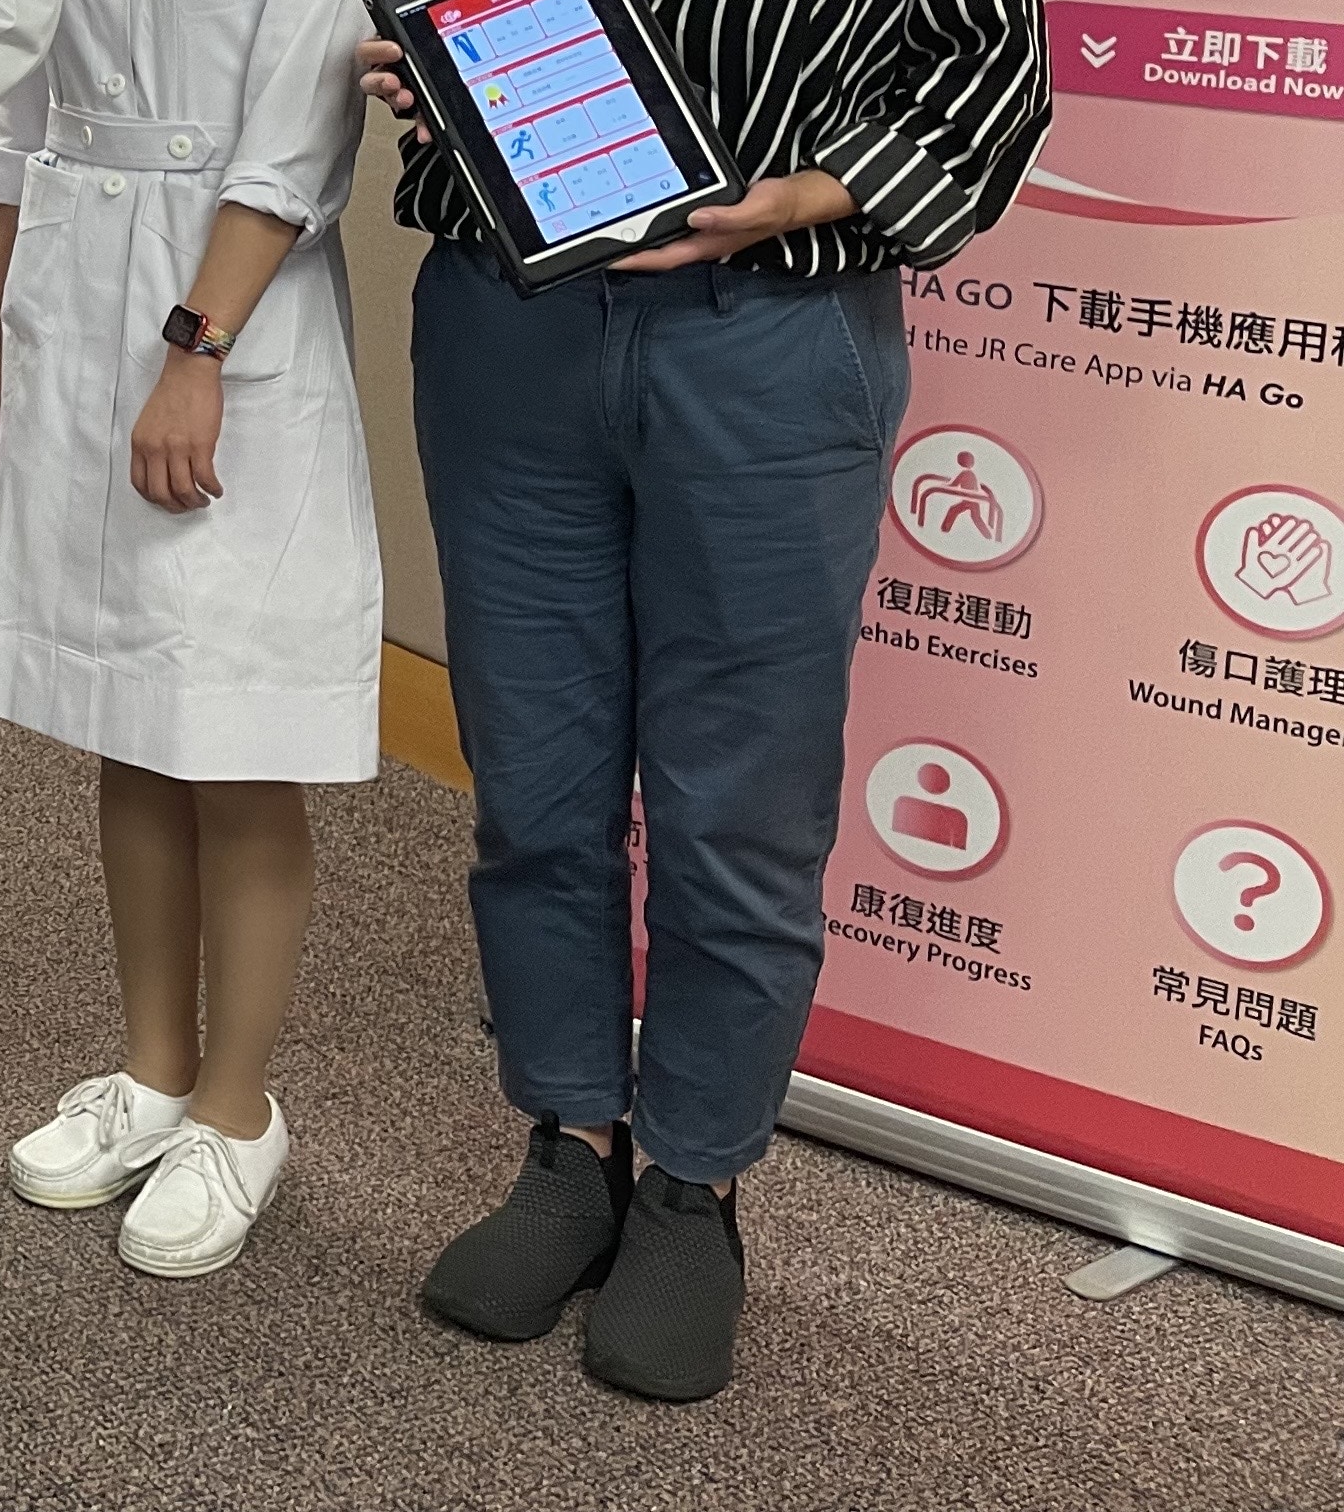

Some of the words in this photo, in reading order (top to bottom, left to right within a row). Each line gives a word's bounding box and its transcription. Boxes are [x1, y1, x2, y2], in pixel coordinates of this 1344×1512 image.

[1144, 64, 1276, 94] Download
[1284, 77, 1344, 100] Now
[1161, 27, 1328, 74] 立即下載
[956, 279, 1012, 309] GO
[924, 329, 968, 356] the
[975, 337, 1005, 362] JR
[1014, 343, 1076, 373] Care
[1083, 355, 1143, 387] App
[1151, 365, 1192, 392] via
[1203, 374, 1246, 401] HA
[1259, 382, 1304, 409] Go
[876, 575, 1033, 640] 復康運動
[860, 621, 920, 651] ehab
[927, 635, 1039, 678] Exercises
[1178, 638, 1344, 705] 傷口護理
[1127, 678, 1222, 721] Wound
[1230, 702, 1344, 747] Manage
[822, 911, 920, 962] ecovery
[927, 941, 1031, 991] Progress
[850, 883, 1003, 954] 康復進度
[1152, 965, 1319, 1042] 常見問題
[1198, 1024, 1263, 1062] FAQs
